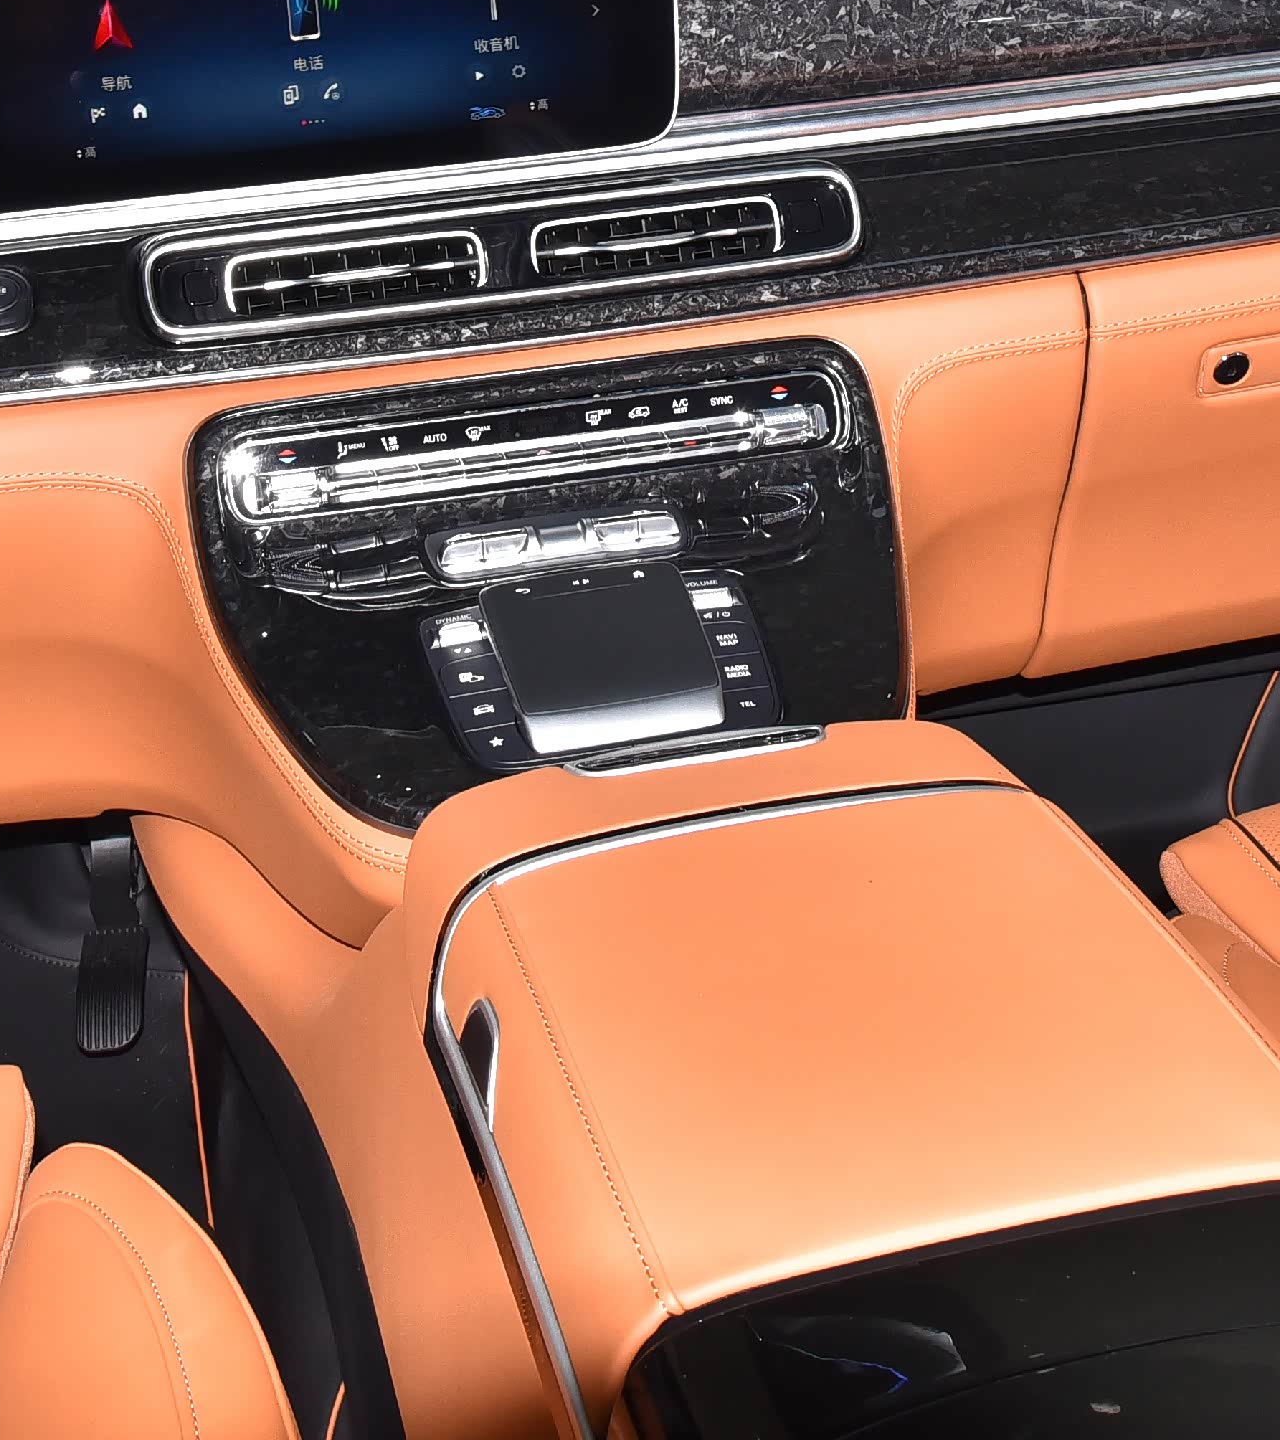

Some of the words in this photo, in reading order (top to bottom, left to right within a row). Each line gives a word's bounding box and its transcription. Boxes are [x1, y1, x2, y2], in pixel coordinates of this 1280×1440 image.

[473, 36, 520, 54] 收音机
[294, 55, 324, 72] 电话
[101, 75, 132, 92] 导航
[537, 99, 549, 110] 高
[85, 146, 96, 158] 高
[672, 398, 689, 409] A/C
[710, 395, 734, 407] SYNC
[423, 433, 447, 444] AUTO
[348, 442, 366, 450] MENU
[685, 579, 718, 588] VOLUME
[435, 613, 472, 625] DYNAMIC
[716, 633, 738, 641] NAVI
[724, 664, 749, 672] RADIO
